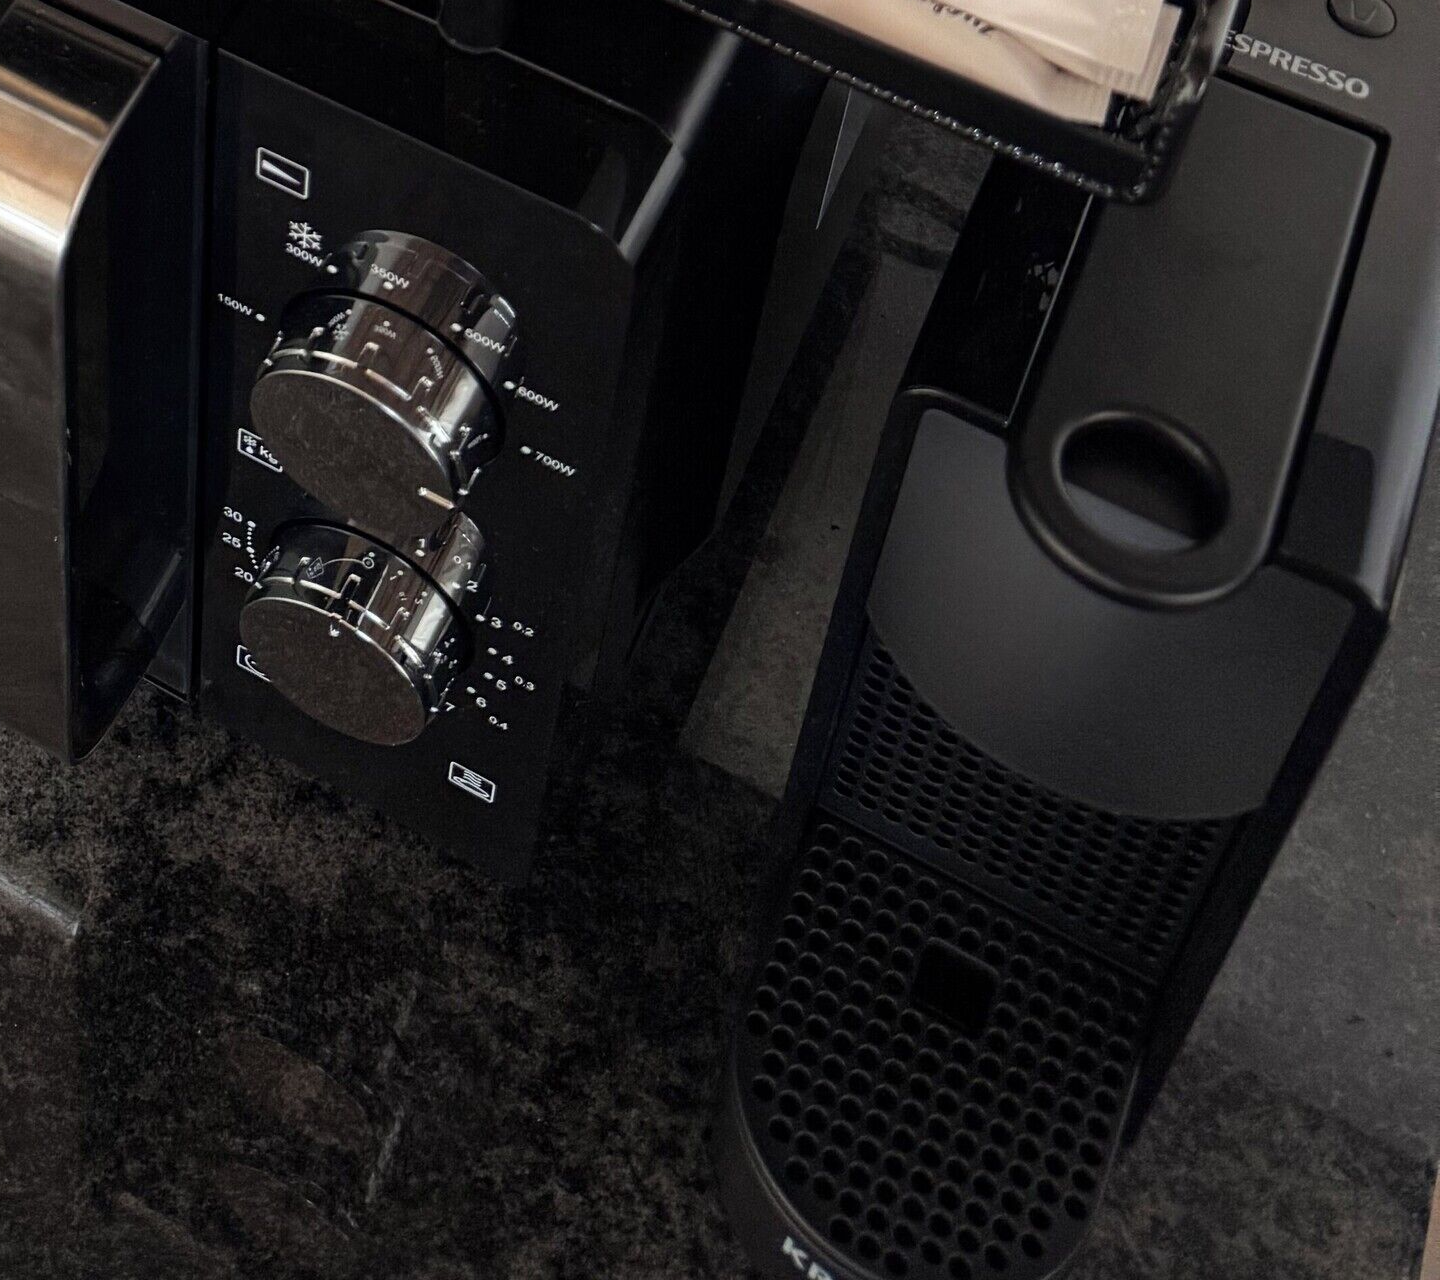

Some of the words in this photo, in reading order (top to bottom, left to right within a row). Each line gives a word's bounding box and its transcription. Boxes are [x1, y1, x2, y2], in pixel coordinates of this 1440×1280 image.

[1223, 30, 1370, 99] ESPRESSO
[285, 243, 324, 267] 300W
[370, 263, 410, 289] 350W
[217, 293, 252, 316] 150W
[518, 386, 559, 412] 600W
[535, 450, 576, 476] 700W
[223, 506, 243, 522] 30
[222, 532, 242, 549] 25
[418, 538, 425, 548] 1
[234, 567, 254, 583] 20
[466, 580, 479, 592] 2
[490, 616, 502, 629] 3
[513, 621, 534, 637] 0.2
[502, 654, 514, 665] 4
[514, 675, 535, 691] 0.3
[445, 701, 456, 712] 7
[489, 715, 508, 730] 0.4
